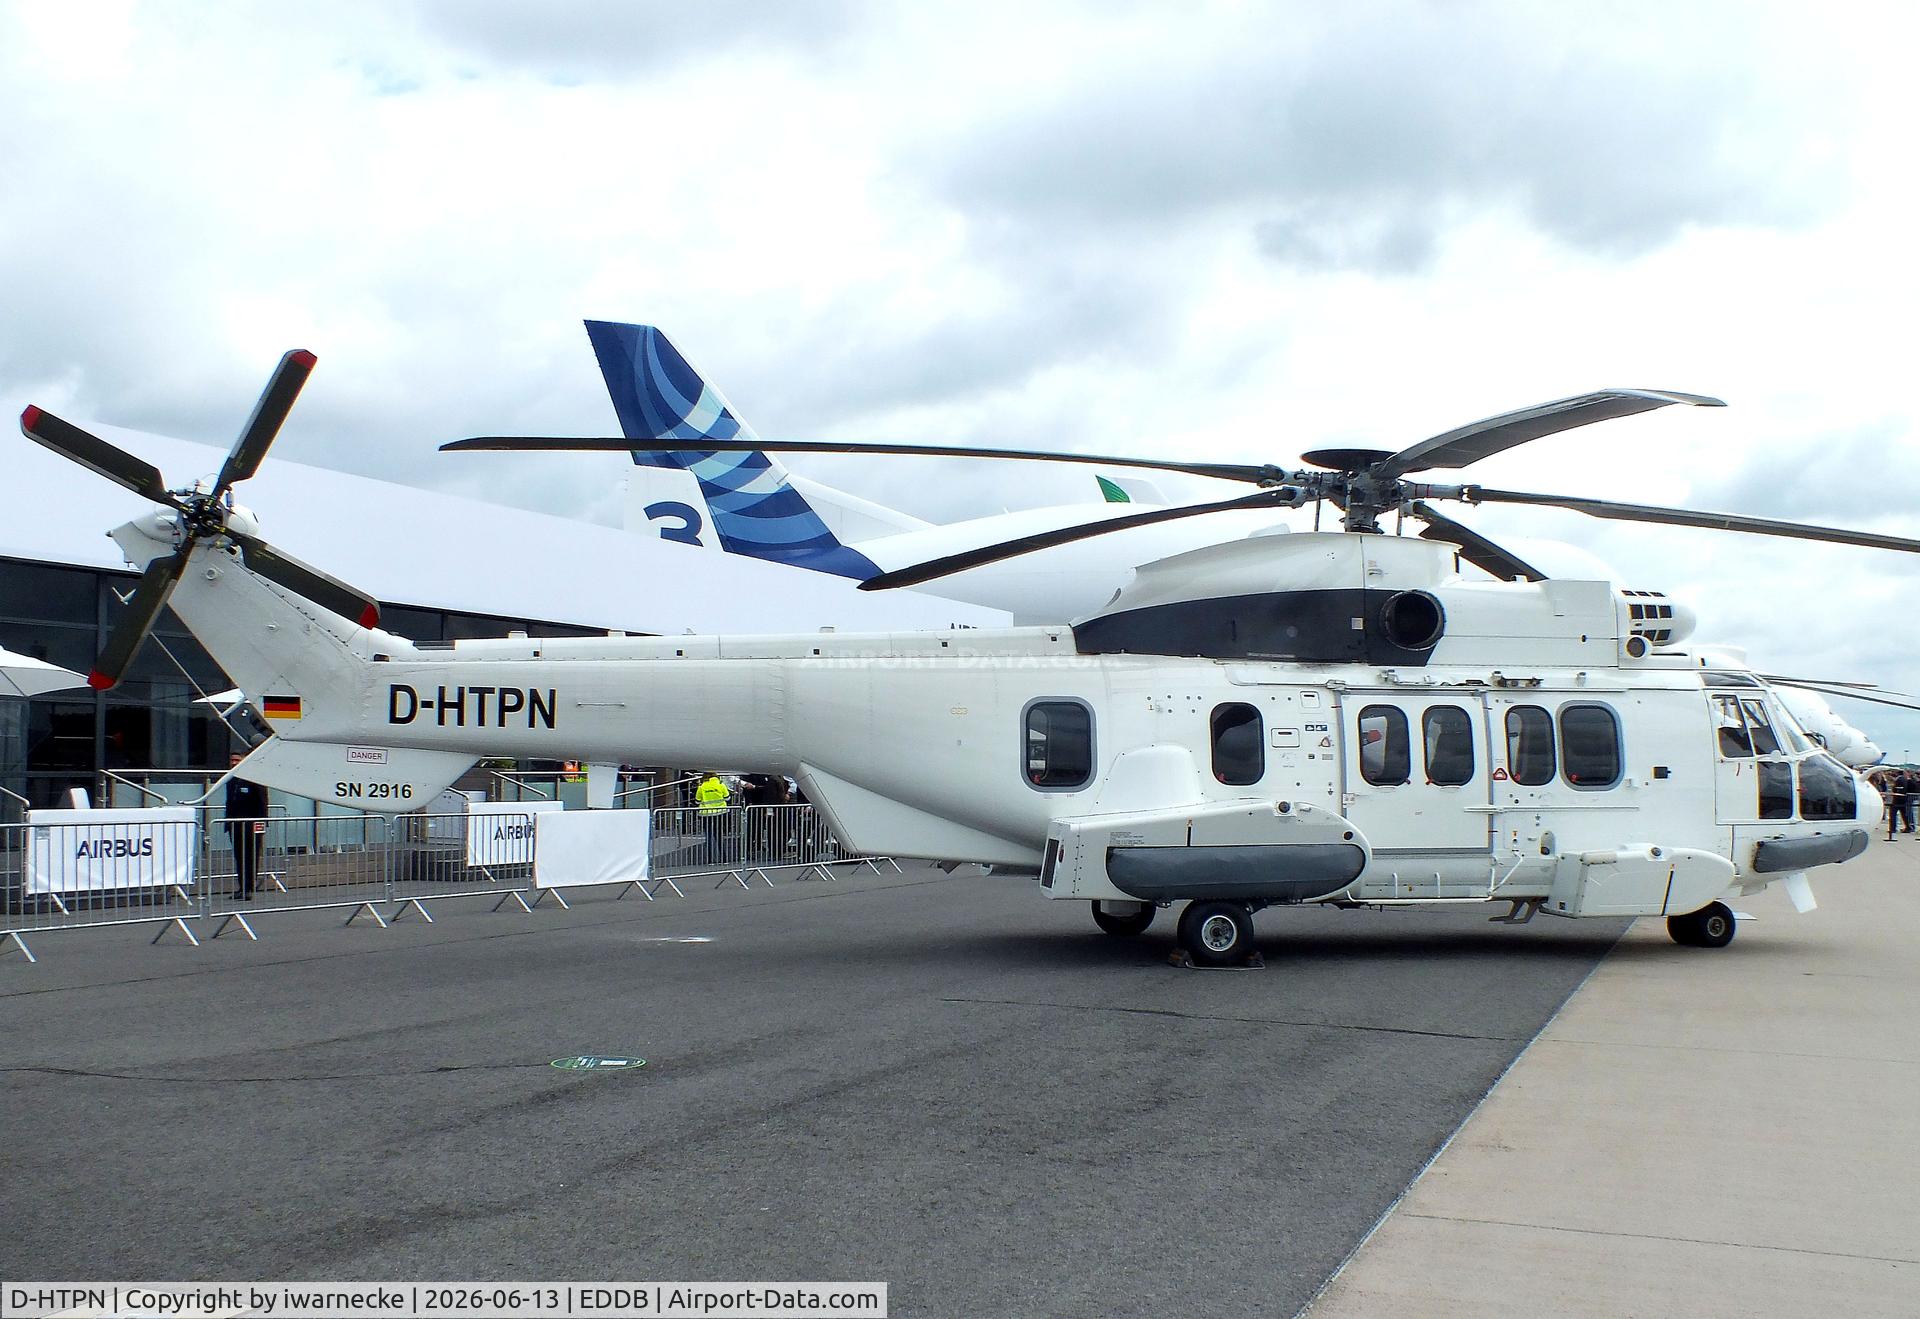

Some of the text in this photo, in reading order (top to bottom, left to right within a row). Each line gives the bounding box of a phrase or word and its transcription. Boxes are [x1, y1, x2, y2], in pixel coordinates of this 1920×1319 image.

[388, 684, 557, 729] D-HTPN
[351, 751, 382, 760] DANGER
[335, 782, 412, 799] SN 2916
[494, 824, 535, 840] ARBU
[77, 838, 153, 860] AIRBUS
